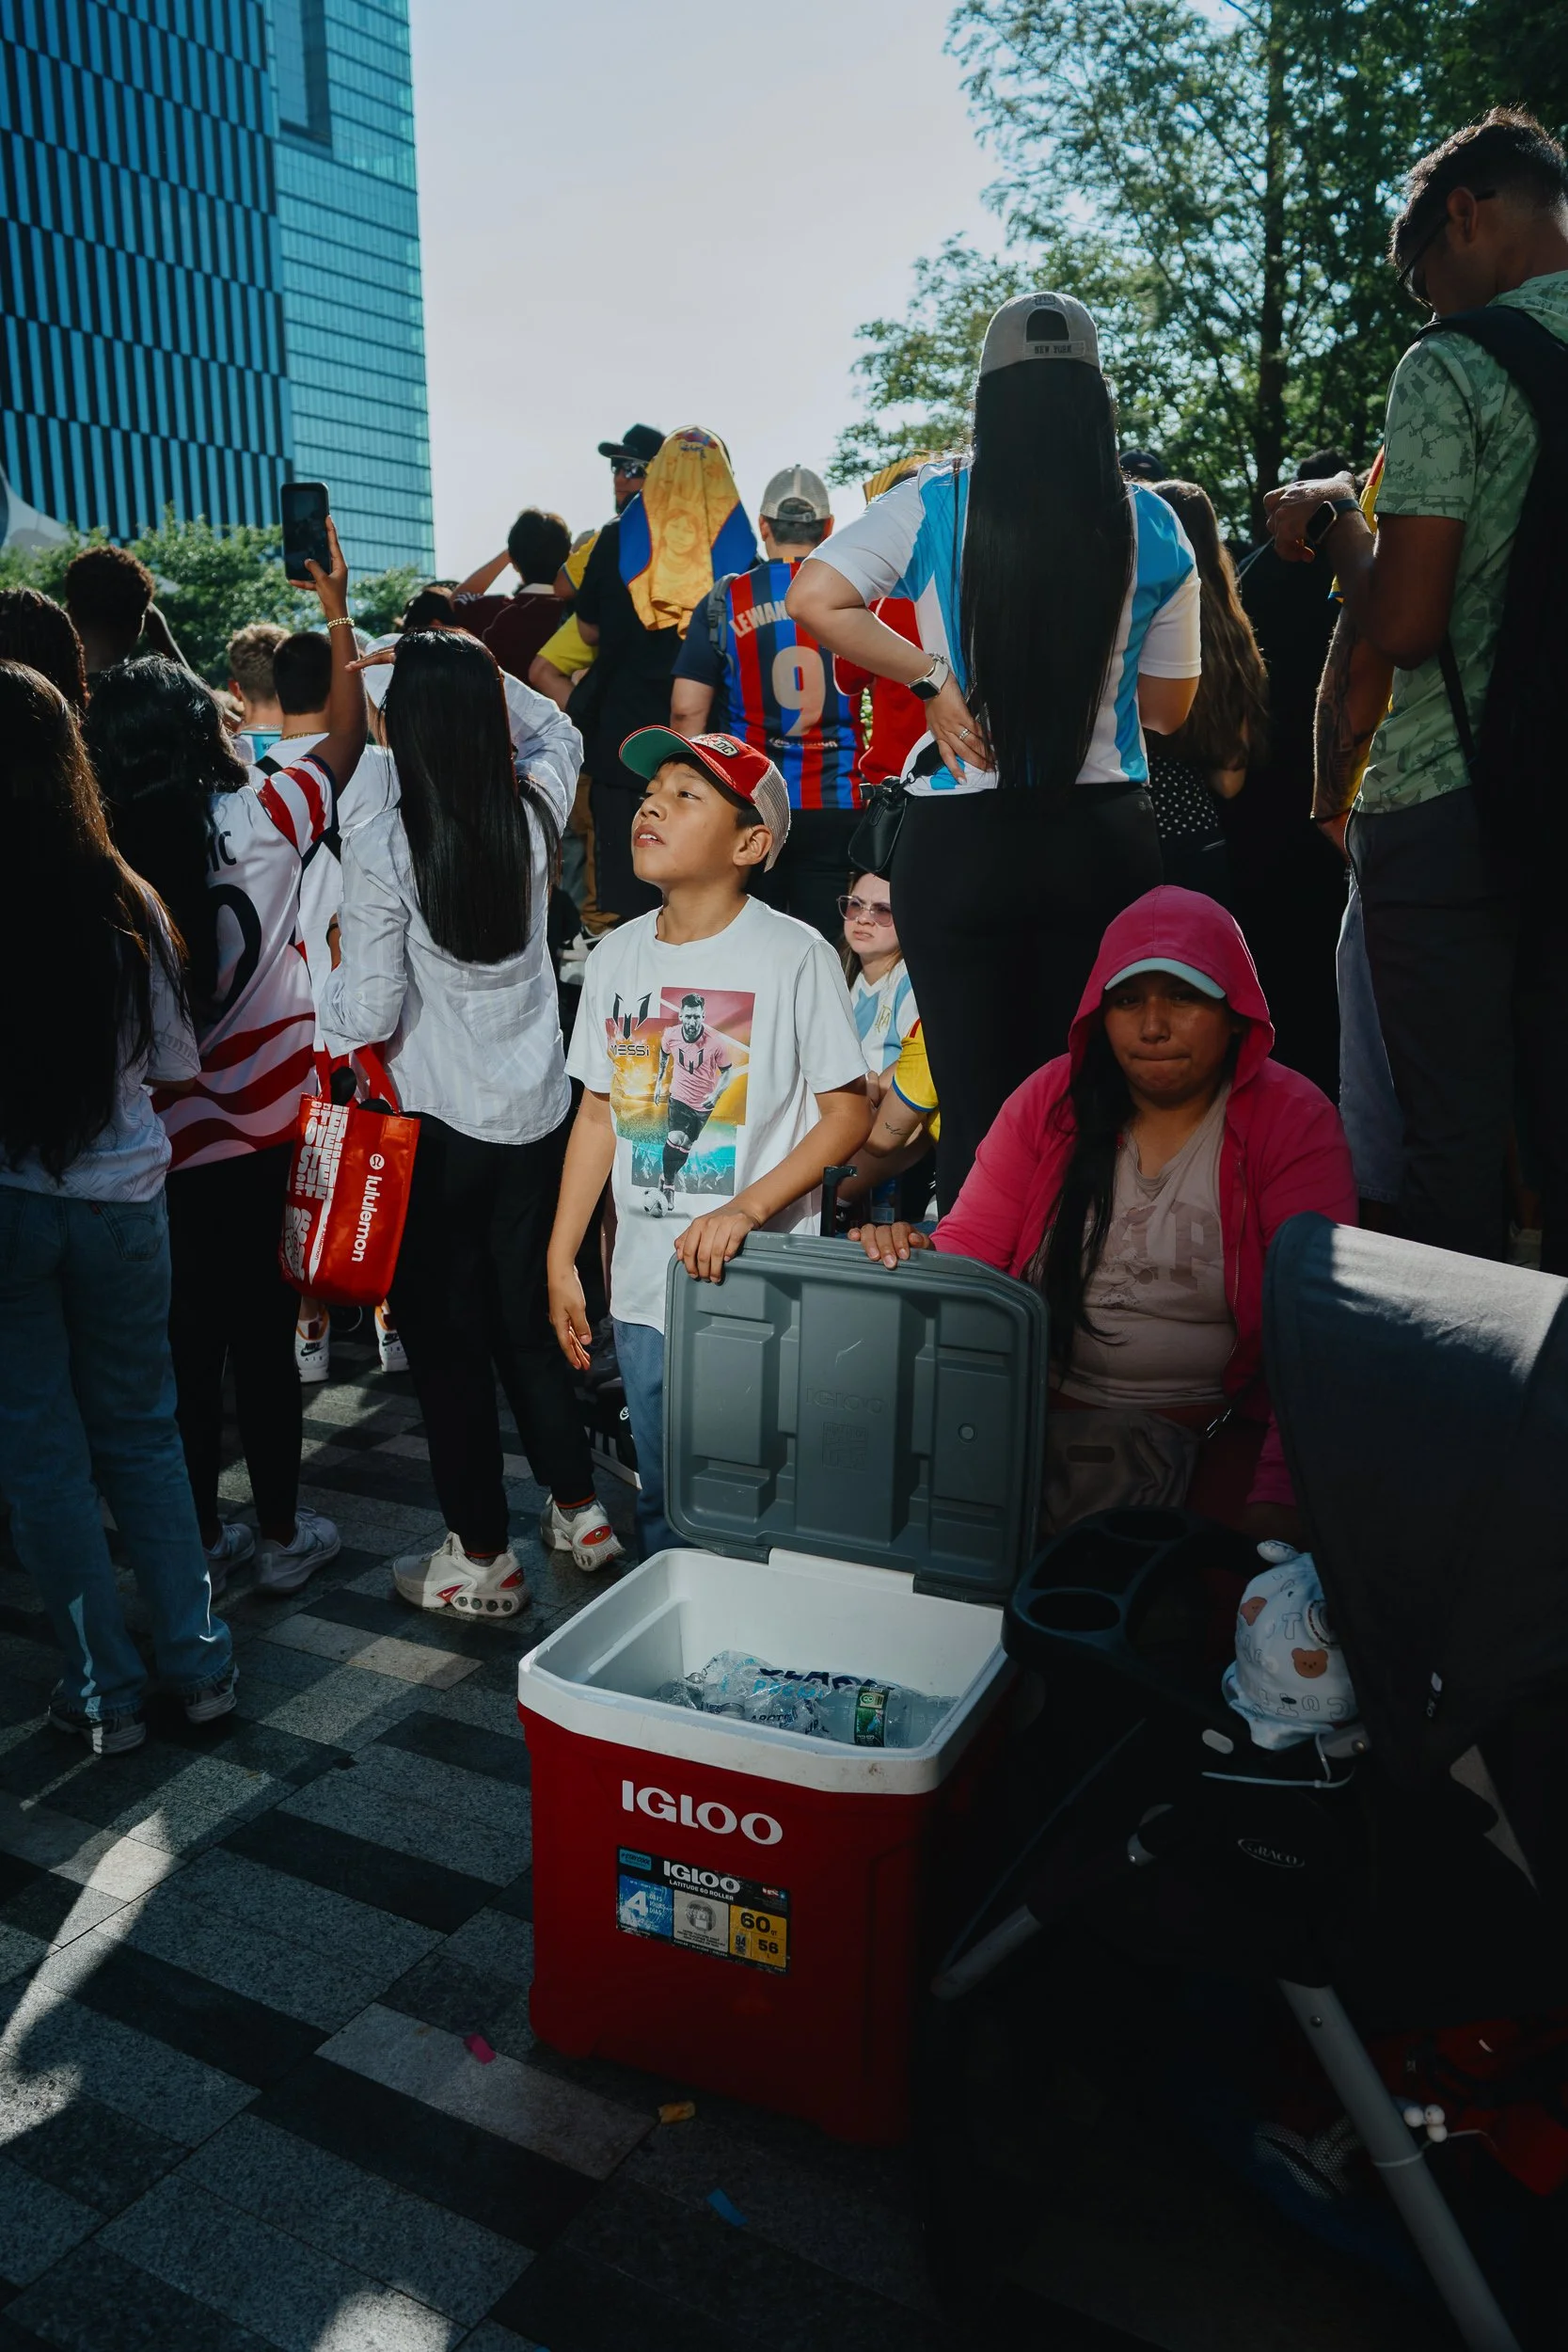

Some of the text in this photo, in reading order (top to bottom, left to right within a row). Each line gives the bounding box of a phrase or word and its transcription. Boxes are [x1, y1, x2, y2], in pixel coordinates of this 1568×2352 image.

[1035, 344, 1072, 354] NEW YORK
[728, 600, 793, 638] LEWAN
[771, 645, 826, 737] 9
[352, 1174, 383, 1263] lululemon
[622, 1779, 784, 1846] IGLOO
[1246, 1842, 1298, 1865] GRACO
[663, 1860, 740, 1894] IGLOO
[625, 1890, 649, 1916] 4
[669, 1880, 699, 1893] LATITUDE
[709, 1889, 734, 1901] ROLLER
[740, 1911, 770, 1933] 60
[758, 1938, 779, 1954] 56
